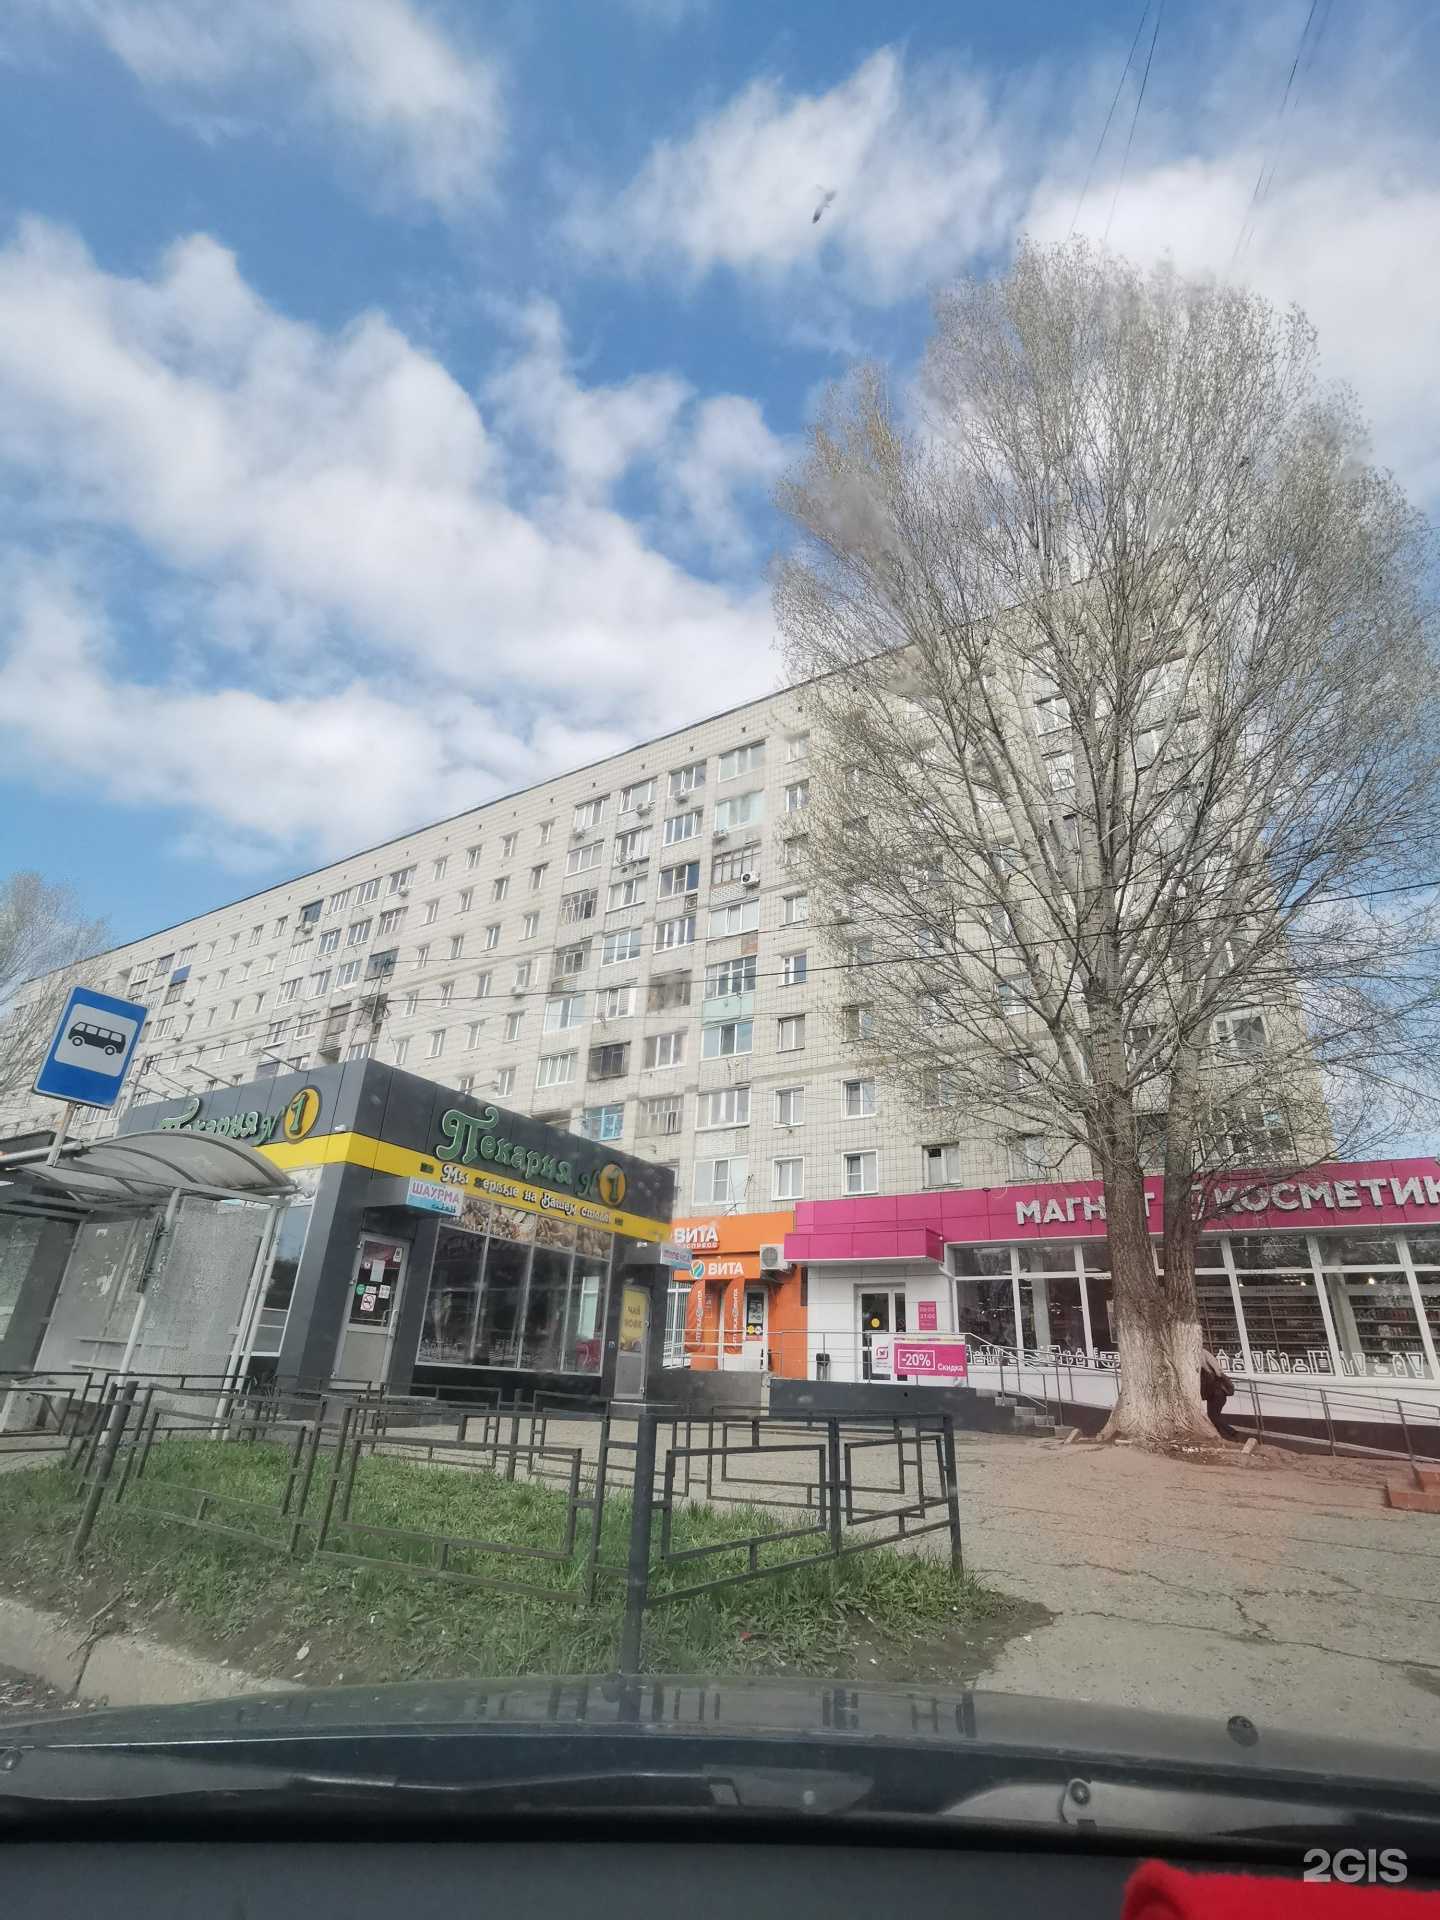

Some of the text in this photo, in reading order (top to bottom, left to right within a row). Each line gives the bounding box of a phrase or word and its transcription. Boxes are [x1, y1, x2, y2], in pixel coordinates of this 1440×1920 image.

[412, 1181, 460, 1203] ШАУРМА
[441, 1163, 469, 1184] Мы
[523, 1190, 537, 1204] на
[541, 1192, 577, 1216] Вашем
[1015, 1192, 1156, 1226] МАГНТ
[674, 1225, 719, 1244] ВИТА
[708, 1261, 744, 1275] ВИТА
[901, 1353, 932, 1367] -20%
[937, 1363, 964, 1373] Скидка
